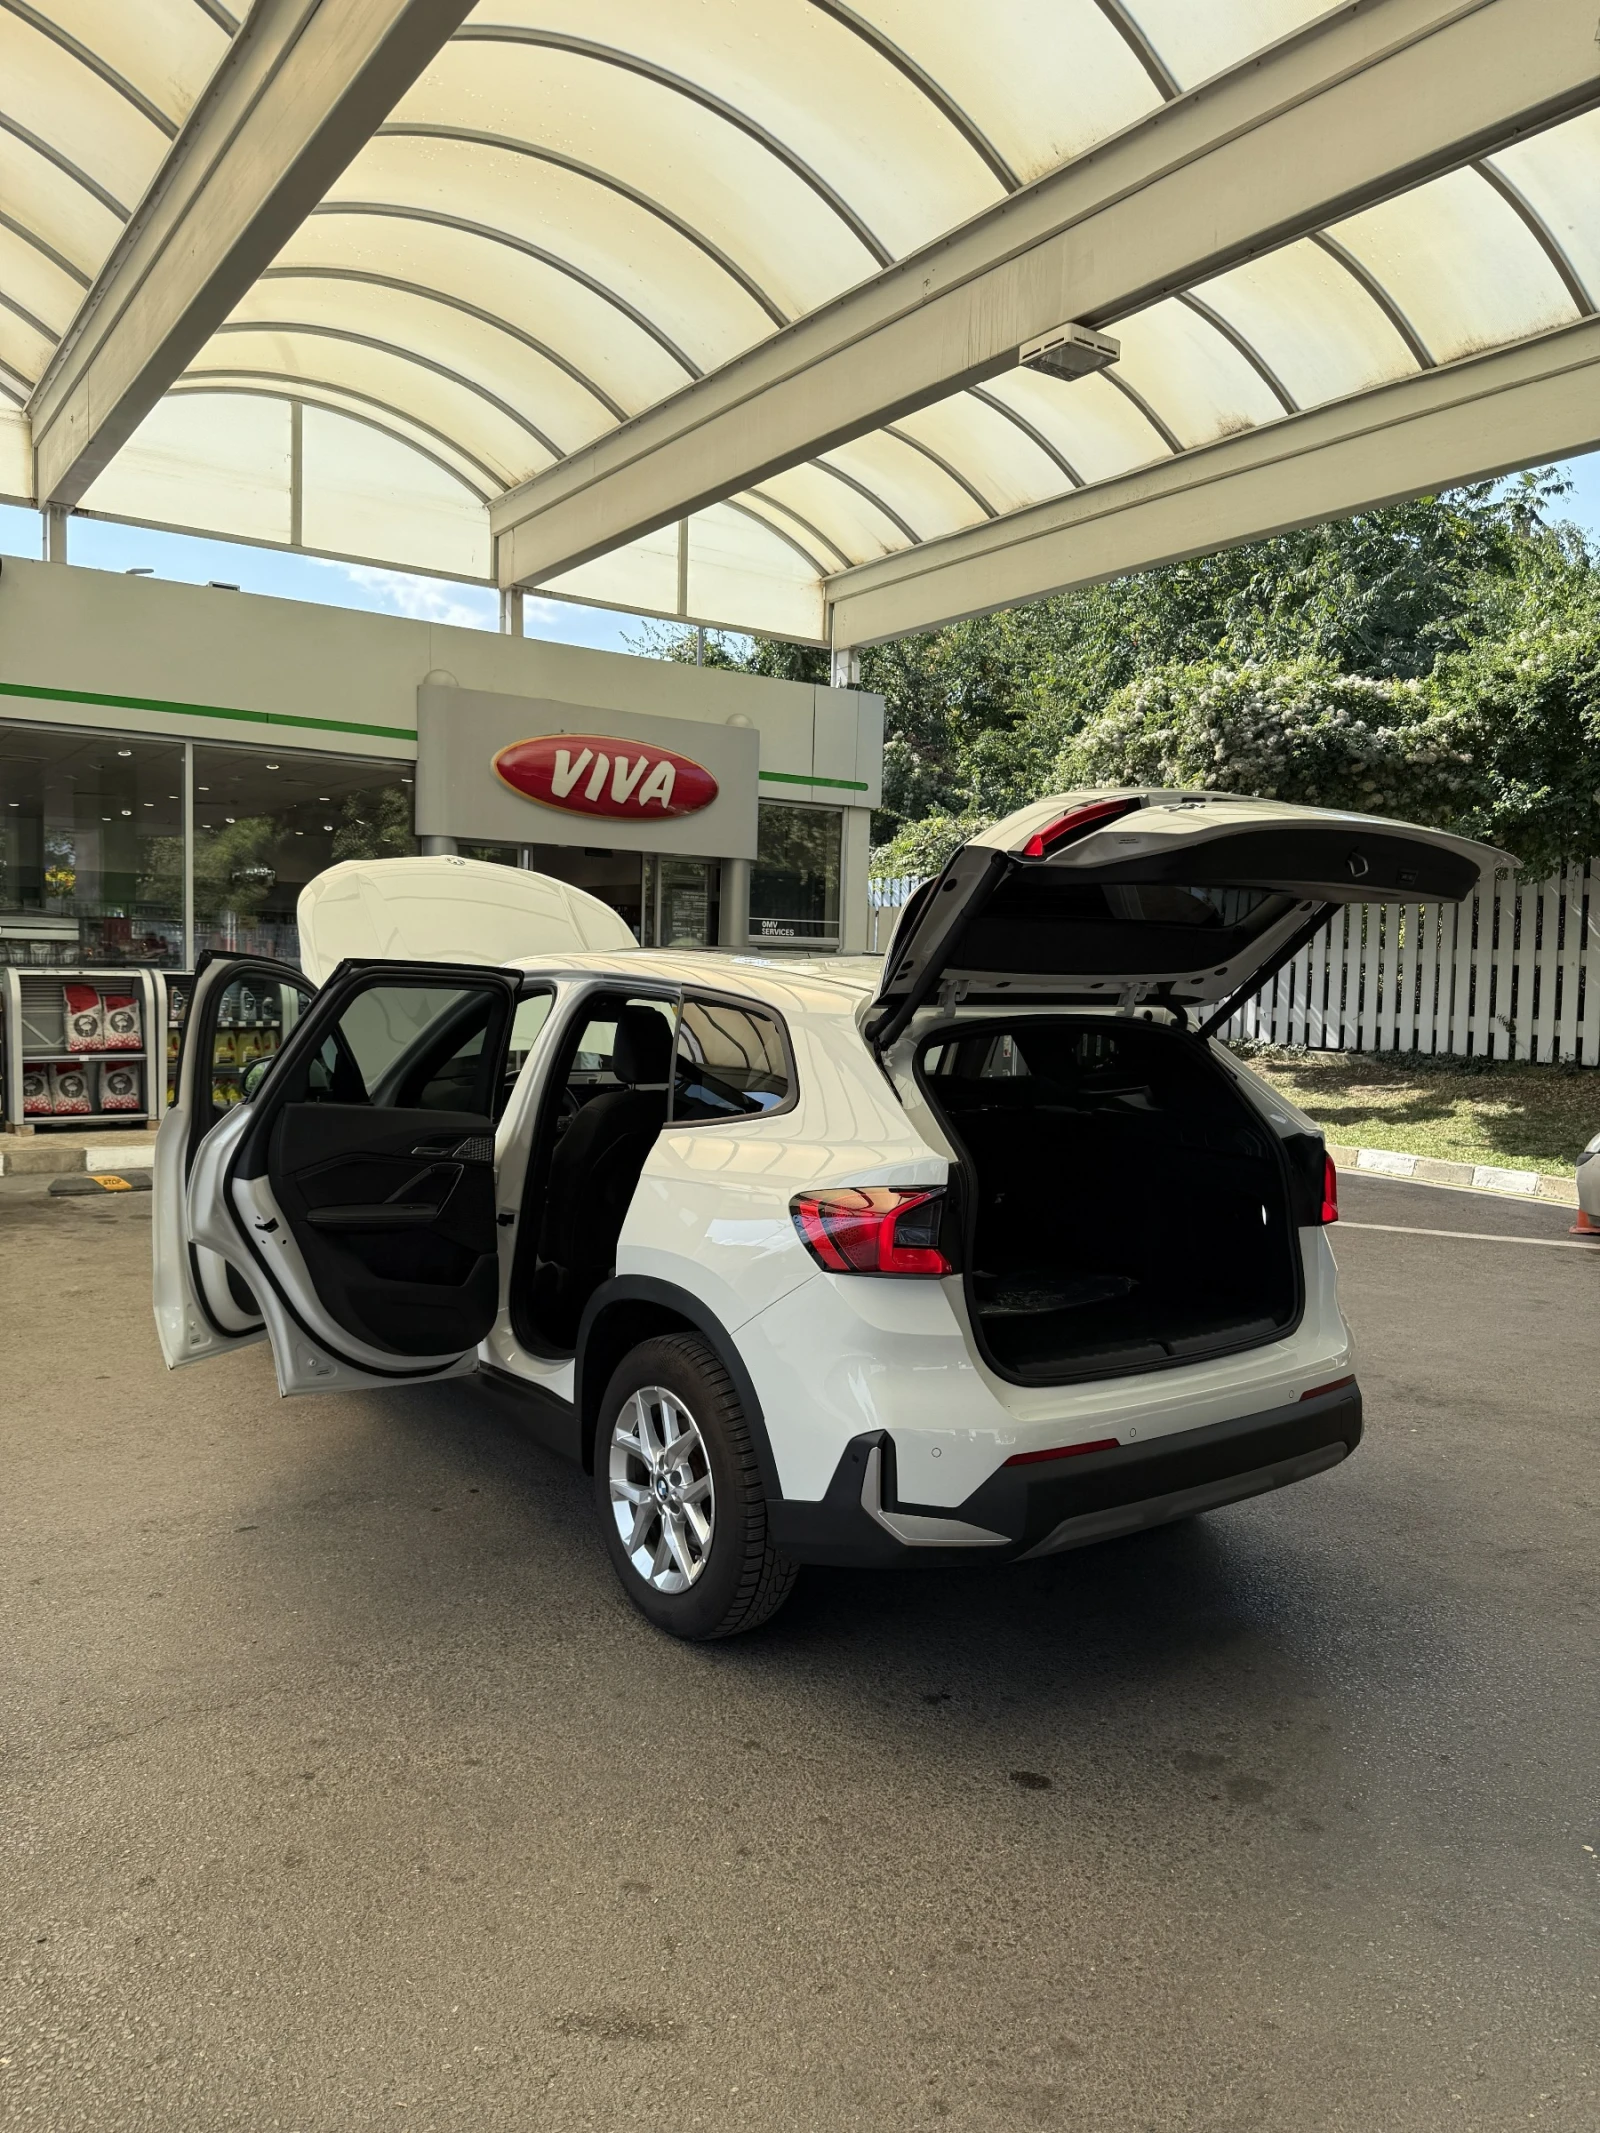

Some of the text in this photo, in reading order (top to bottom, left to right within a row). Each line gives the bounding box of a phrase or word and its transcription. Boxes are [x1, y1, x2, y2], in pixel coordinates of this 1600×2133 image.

[551, 747, 676, 809] VIVA
[762, 920, 778, 928] OMV
[761, 928, 795, 936] SERVICES
